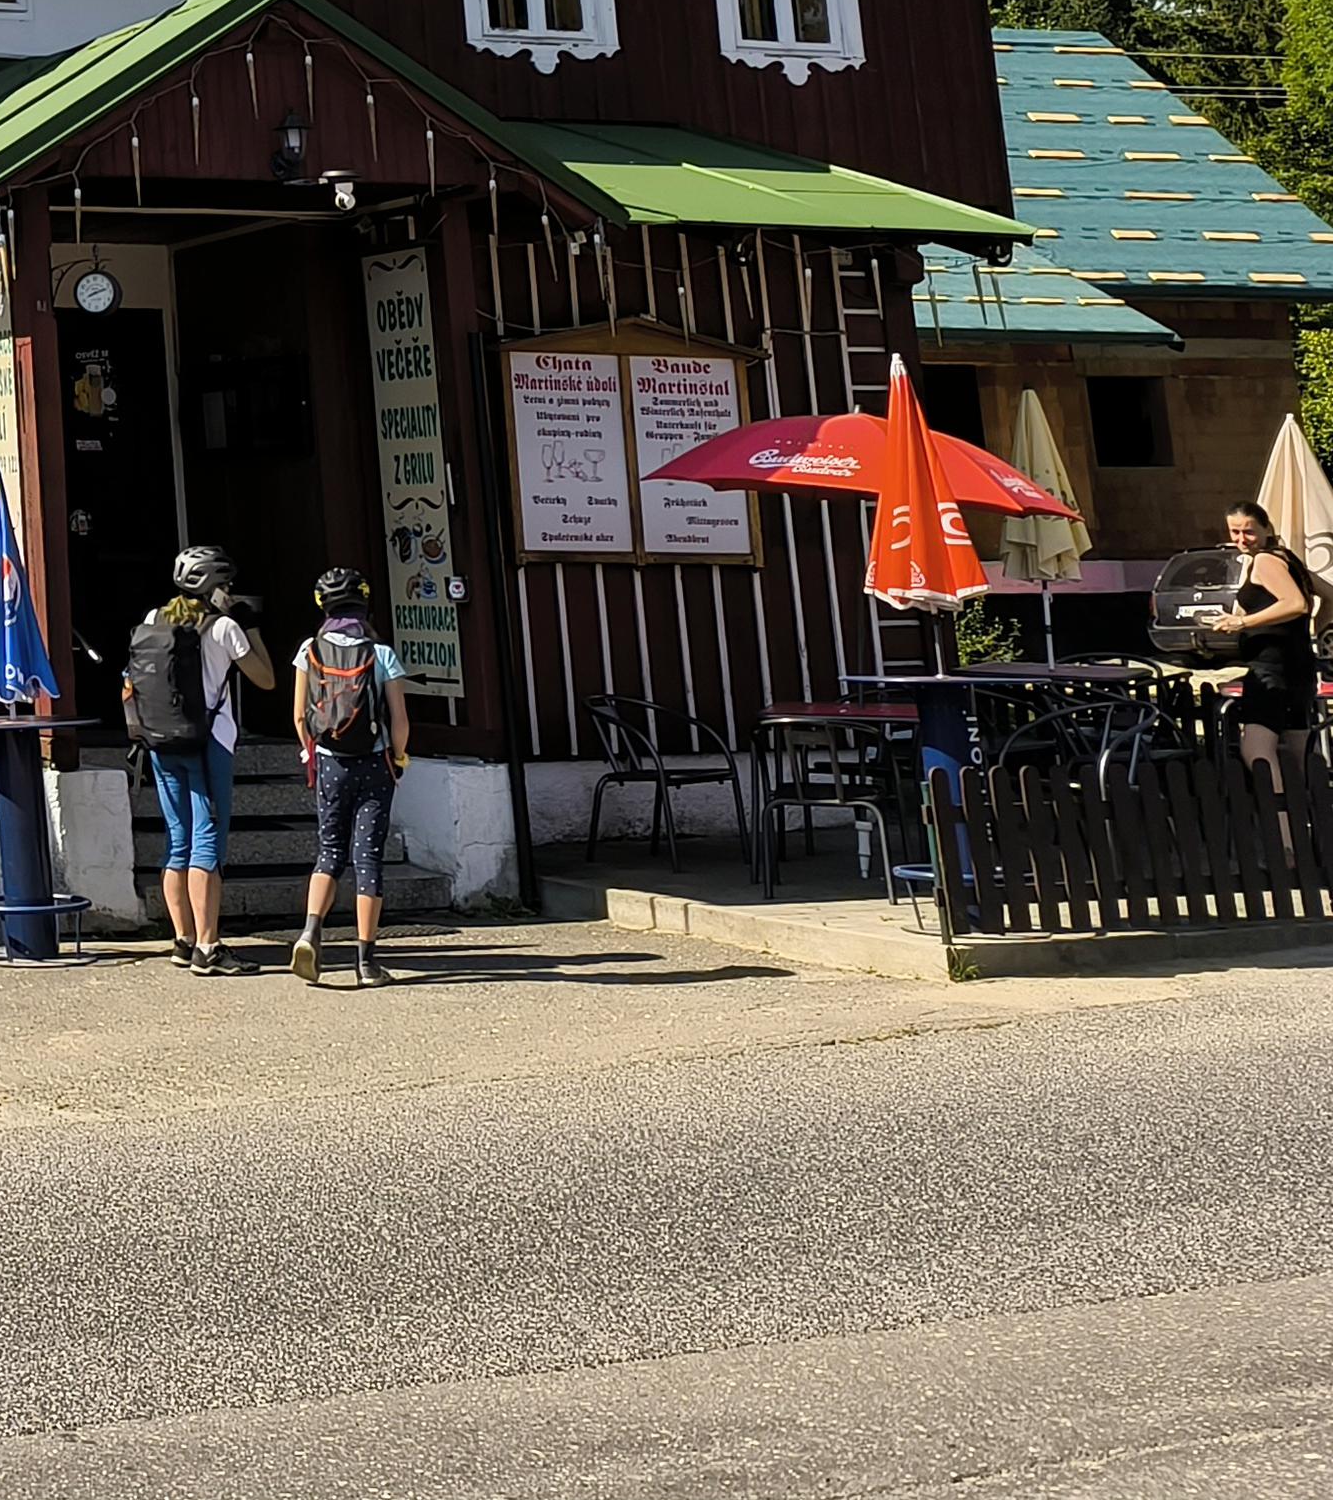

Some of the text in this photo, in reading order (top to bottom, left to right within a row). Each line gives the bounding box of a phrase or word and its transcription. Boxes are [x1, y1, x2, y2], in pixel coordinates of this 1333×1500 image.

[376, 290, 424, 332] OBĚDY
[377, 336, 433, 382] VEČEŘE
[535, 355, 592, 373] Chata
[651, 358, 712, 375] Baude
[514, 373, 583, 392] Martinské
[637, 376, 731, 396] Martinstal
[381, 403, 438, 440] SPECIALITY
[393, 452, 435, 486] Z GRILU
[395, 604, 457, 632] RESTAURACE
[401, 640, 457, 668] PENZION
